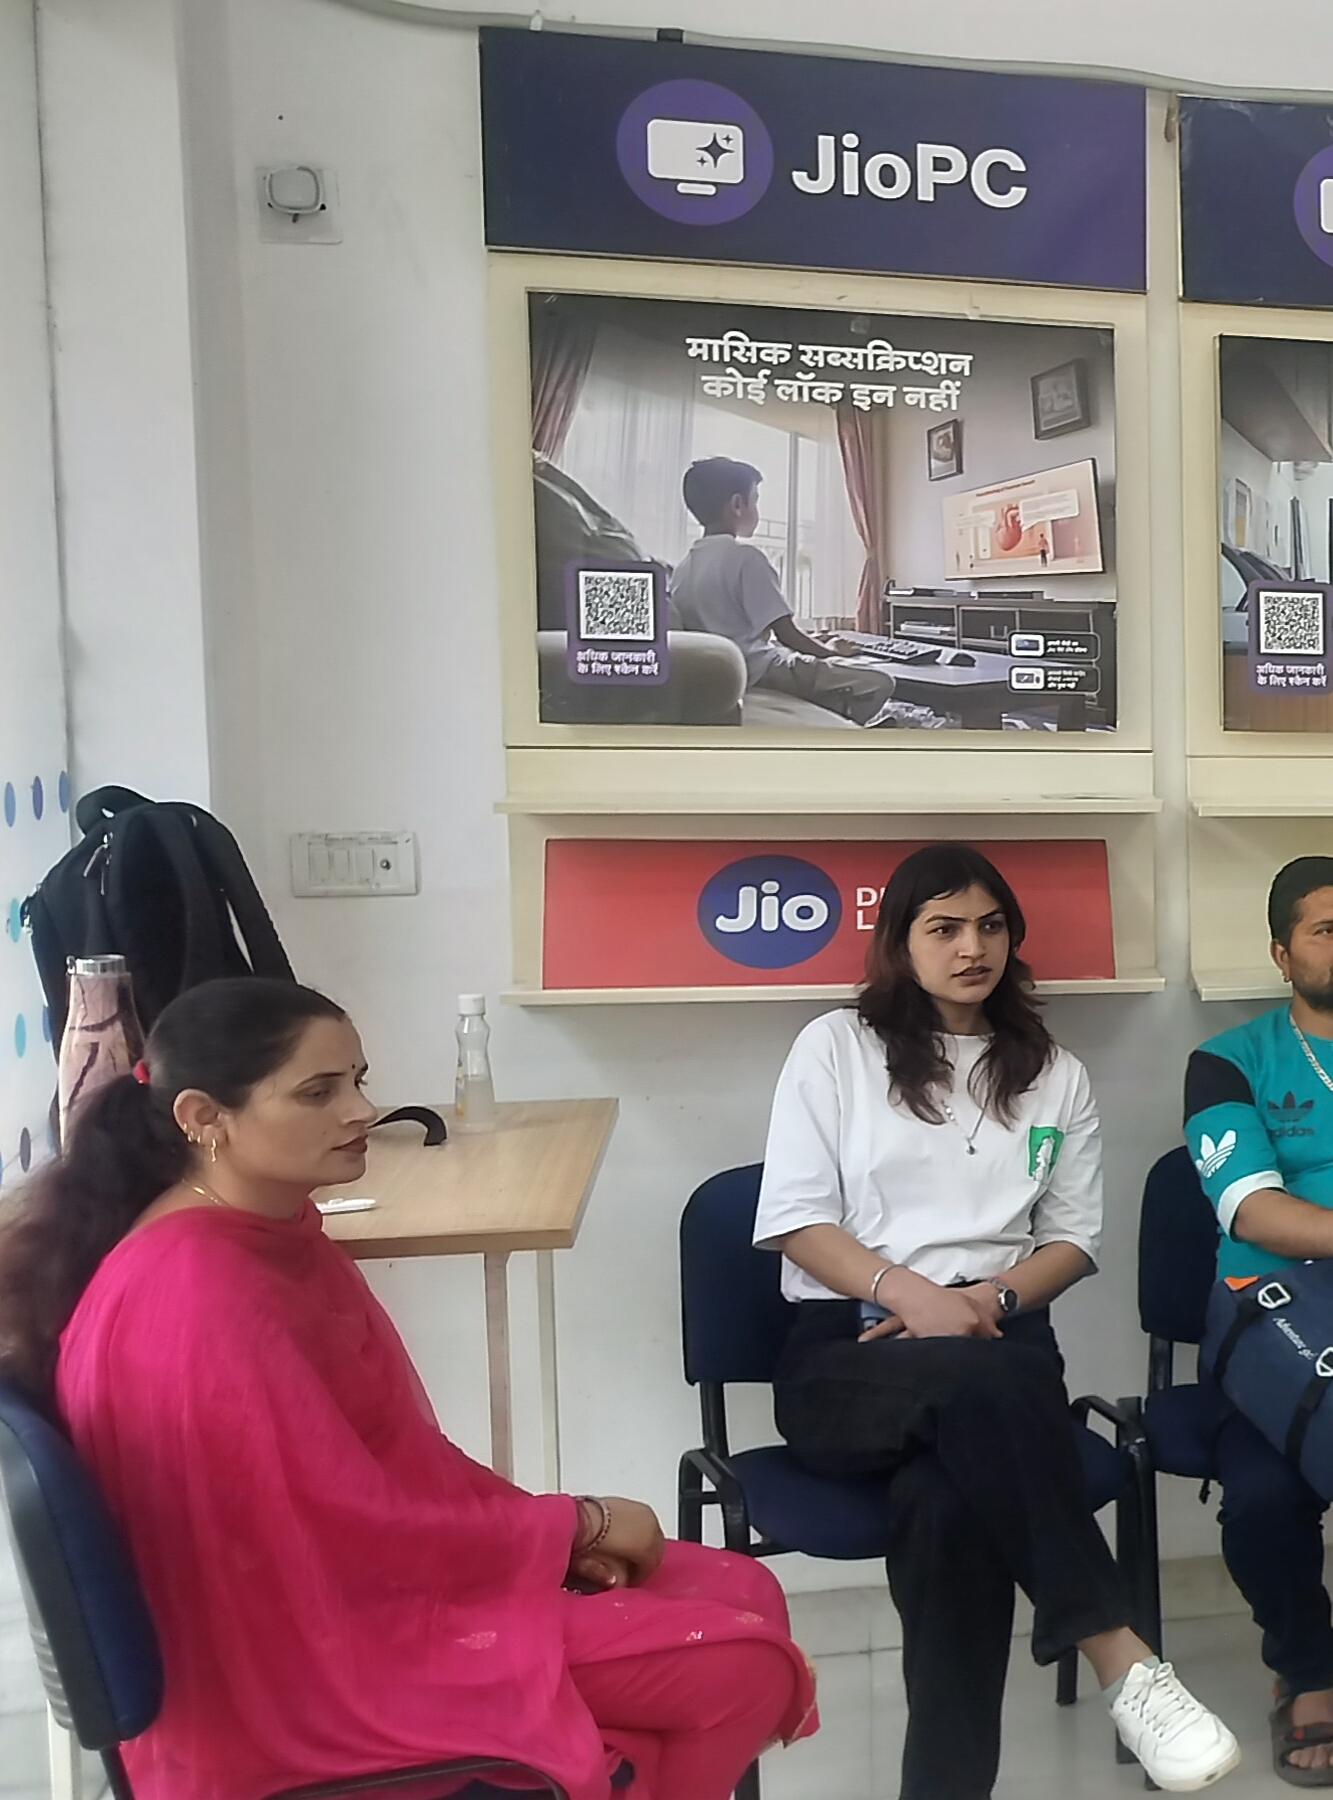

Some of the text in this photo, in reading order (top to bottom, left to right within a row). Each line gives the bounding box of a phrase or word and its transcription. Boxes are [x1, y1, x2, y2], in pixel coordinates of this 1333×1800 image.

[791, 132, 1028, 209] JioPC
[685, 331, 974, 376] मासिक सब्सक्रिप्शन
[701, 367, 962, 412] कोई लॉक इन नहीं
[715, 880, 829, 934] Jio
